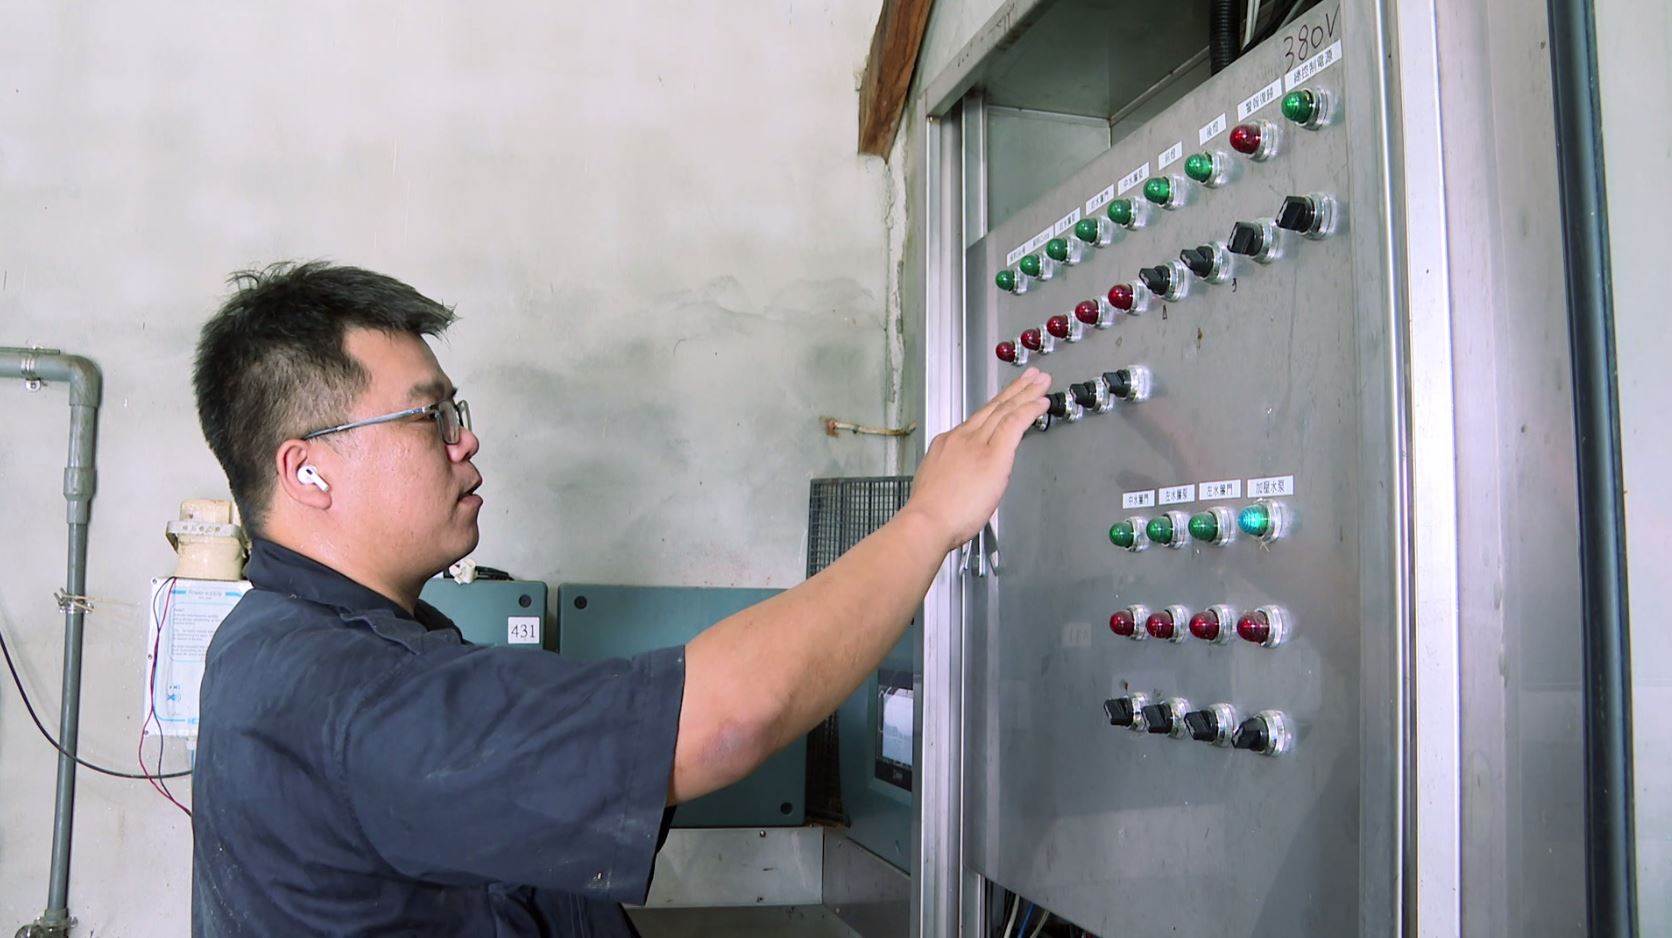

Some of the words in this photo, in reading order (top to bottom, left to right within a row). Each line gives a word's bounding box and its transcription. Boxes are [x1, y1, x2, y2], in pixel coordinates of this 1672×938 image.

[1284, 2, 1340, 73] 380V
[1256, 480, 1285, 495] 加壓水泵
[511, 624, 535, 638] 431
